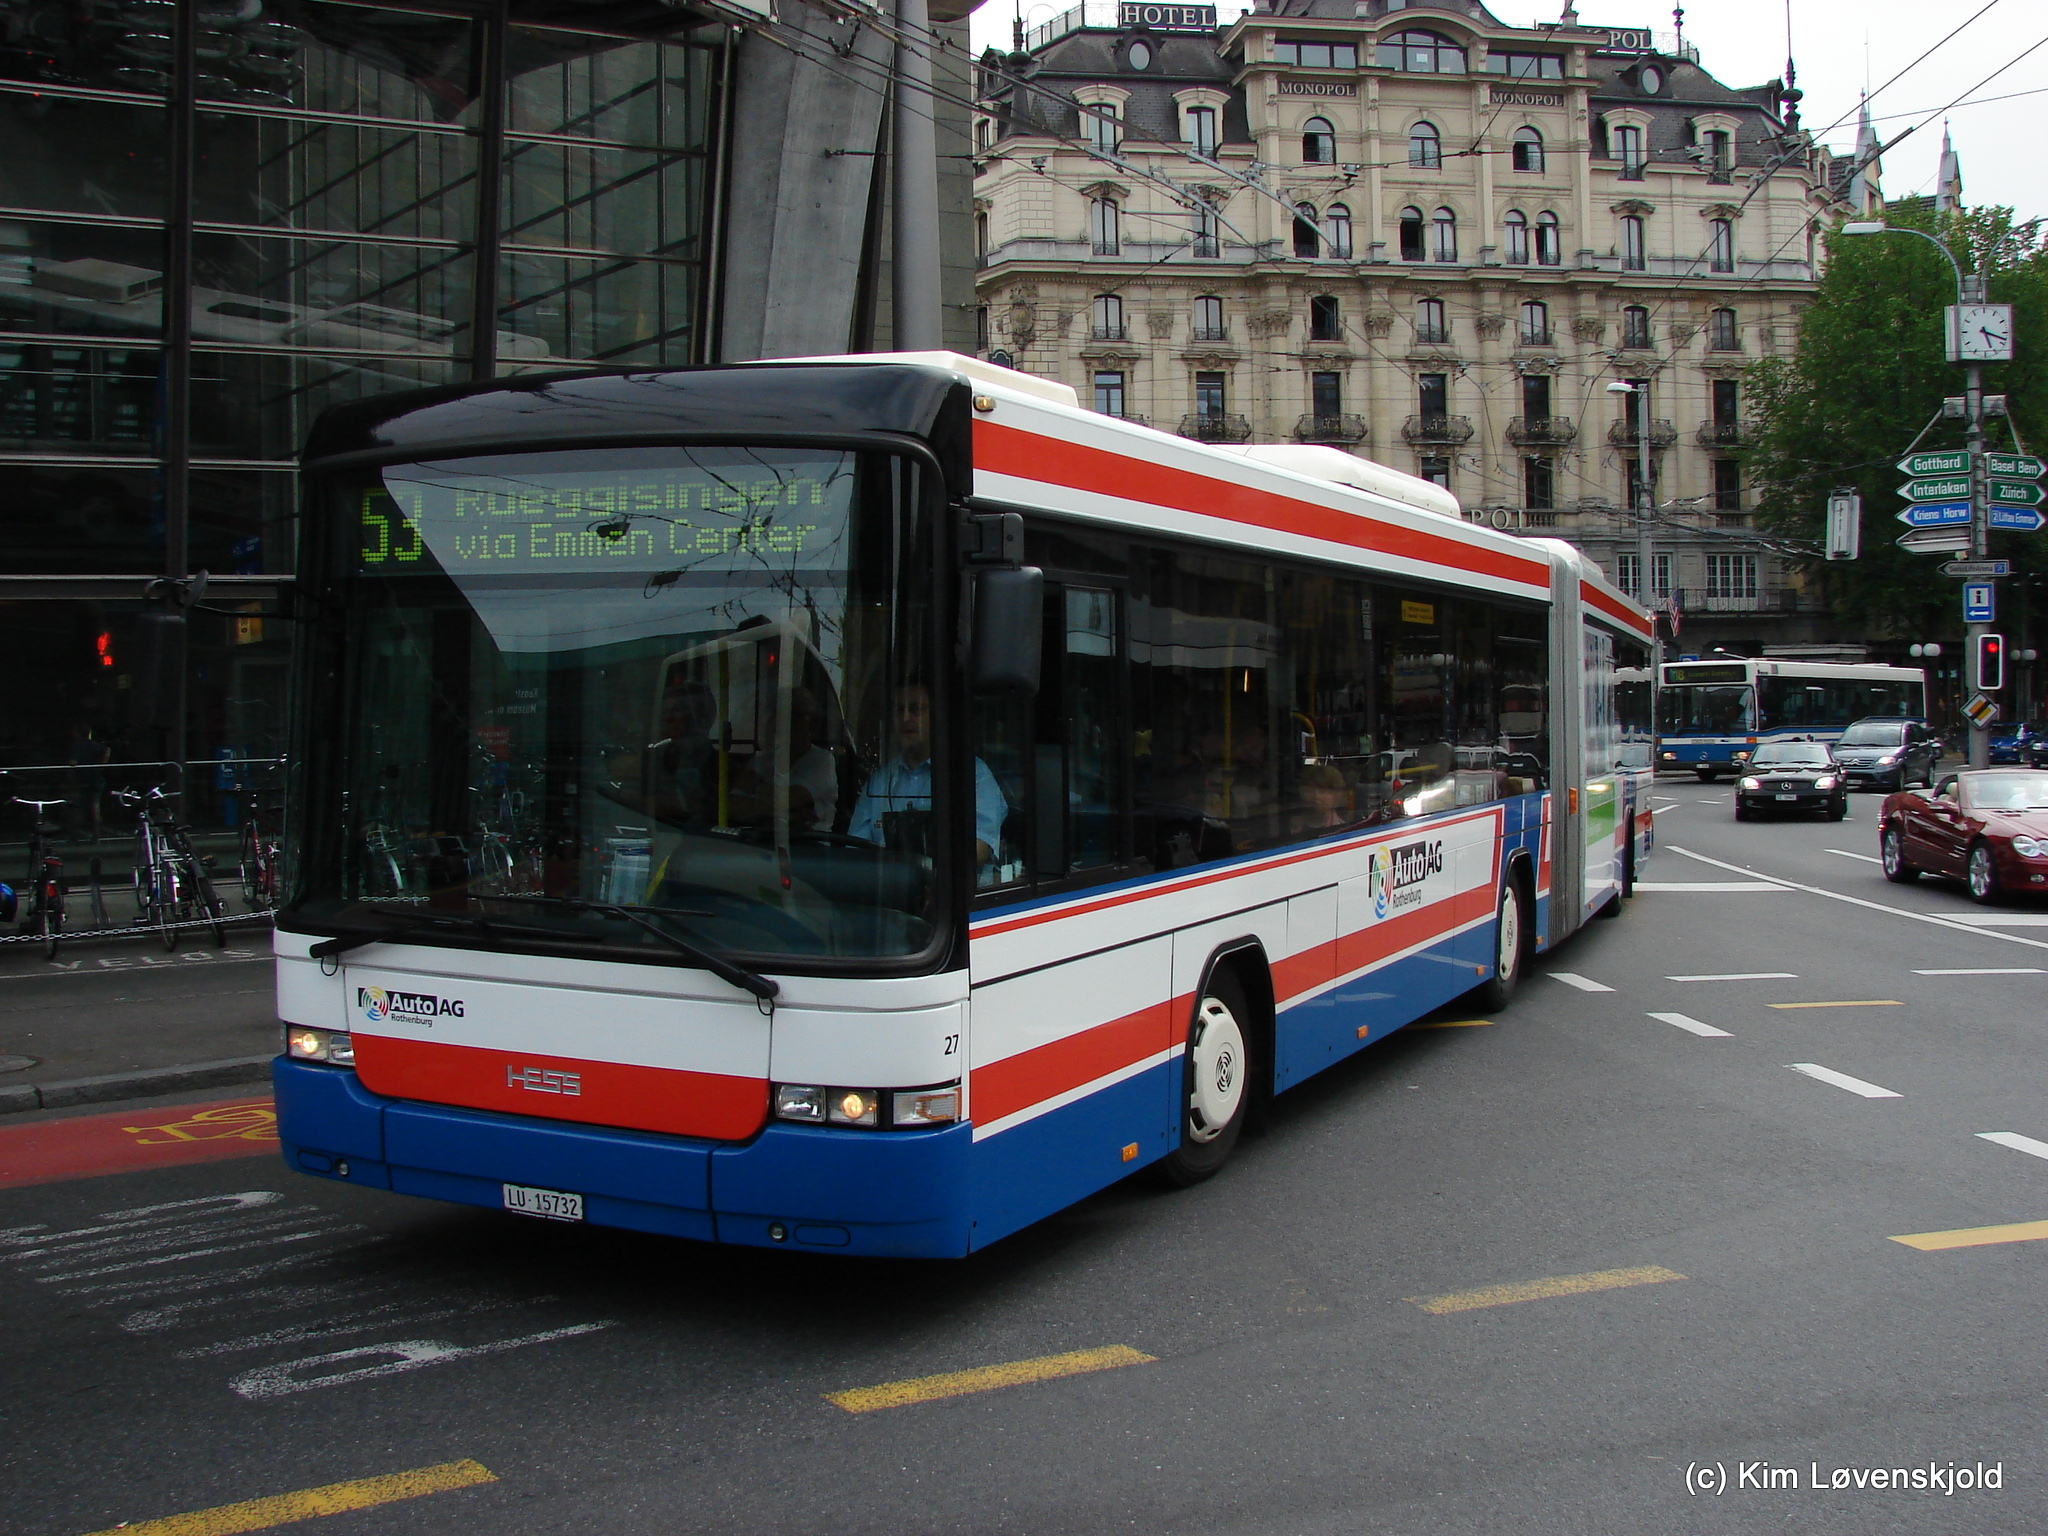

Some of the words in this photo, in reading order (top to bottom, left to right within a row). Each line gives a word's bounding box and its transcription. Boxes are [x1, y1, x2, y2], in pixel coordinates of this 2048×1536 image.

[1122, 5, 1215, 26] HOTEL
[1281, 82, 1355, 96] MONOPOL
[1491, 92, 1562, 106] MONOPOL
[1914, 456, 1961, 471] Gotthard
[1991, 459, 2014, 472] Basel
[2017, 461, 2038, 475] Bern
[1913, 481, 1967, 497] Interlaken
[1999, 485, 2027, 500] Zürich
[1913, 510, 1939, 522] Kriens
[1943, 507, 1966, 519] Horw
[2015, 513, 2036, 524] Emmen
[361, 486, 423, 562] 53
[455, 524, 516, 560] via
[531, 522, 653, 558] Emmen
[669, 515, 817, 555] Center
[1393, 847, 1424, 887] Auto
[1426, 839, 1443, 876] AG
[1393, 886, 1422, 909] Rothenburg
[51, 950, 256, 970] VELOS
[390, 993, 435, 1016] Auto
[439, 998, 464, 1018] AG
[391, 1013, 433, 1028] Rothenburg
[944, 1033, 959, 1056] 27
[507, 1064, 581, 1097] HESS
